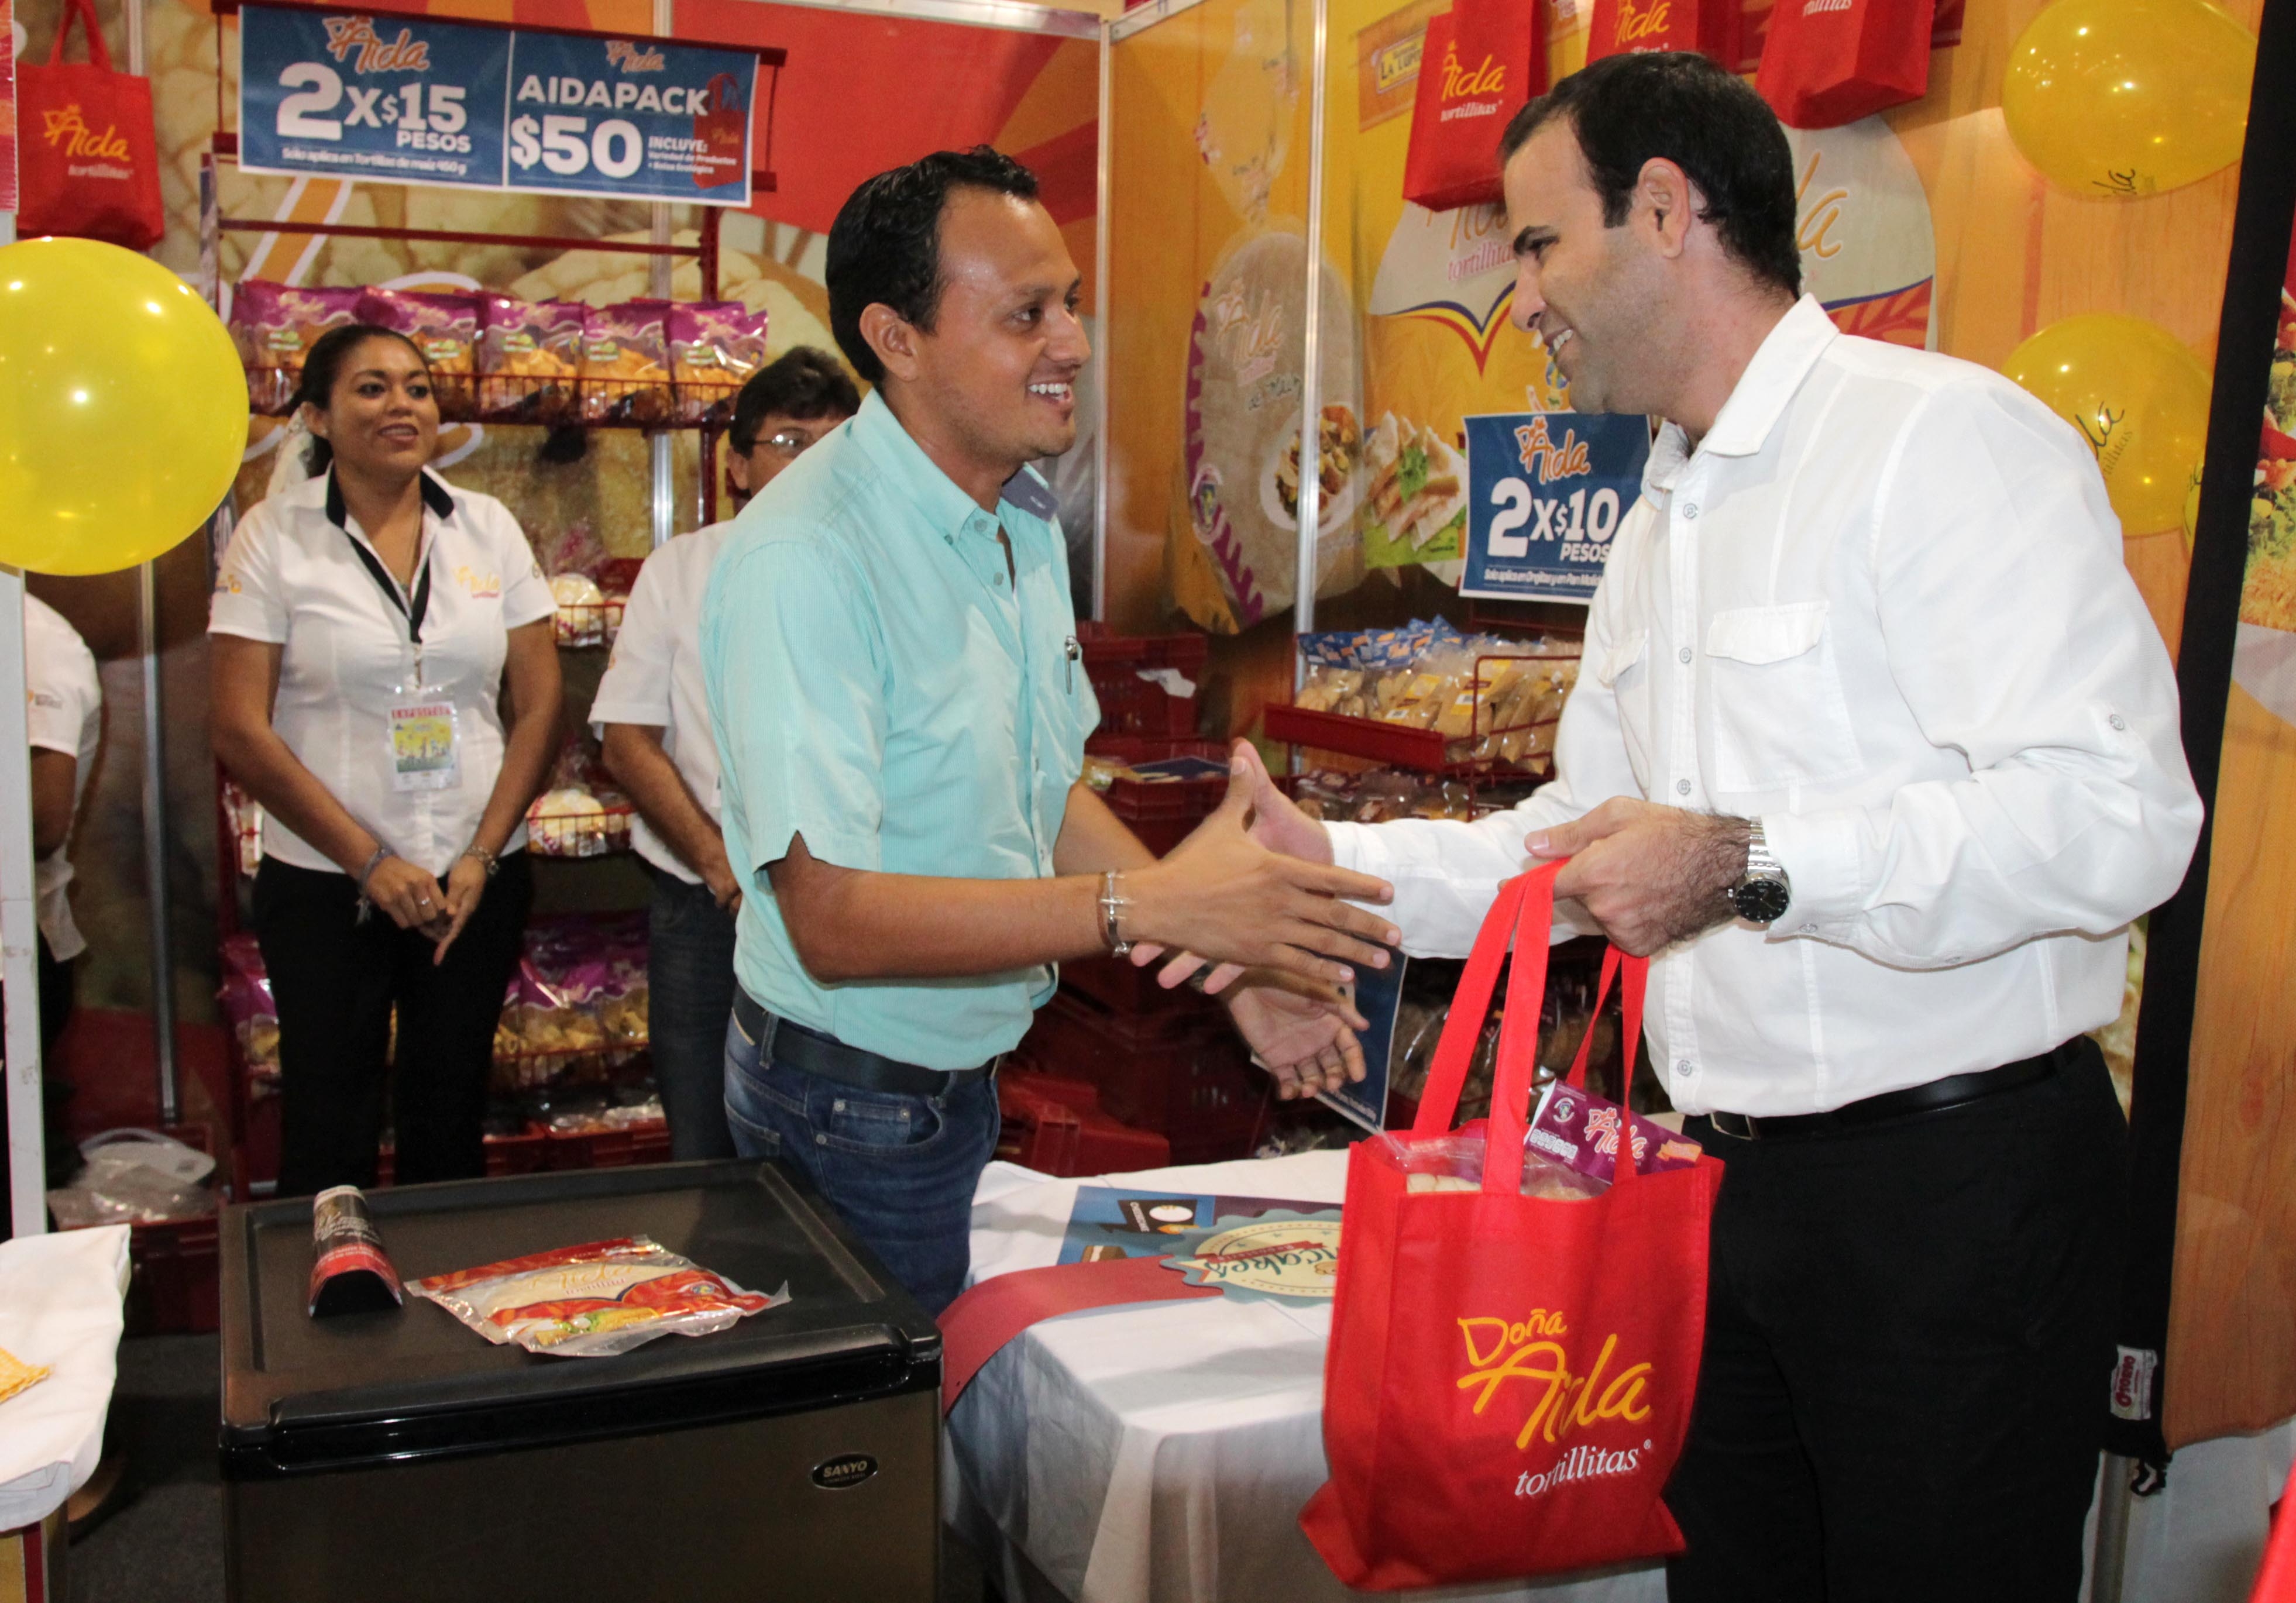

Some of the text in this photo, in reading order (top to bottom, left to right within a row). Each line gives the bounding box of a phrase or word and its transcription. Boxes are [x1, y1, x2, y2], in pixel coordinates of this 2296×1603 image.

[396, 130, 472, 153] PESOS
[510, 113, 643, 179] $50
[1559, 542, 1610, 563] PESOS
[1457, 1308, 1568, 1367] Doña
[1456, 1333, 1652, 1450] Aida
[823, 1460, 868, 1478] SANYO
[1514, 1444, 1639, 1497] tortillitas
